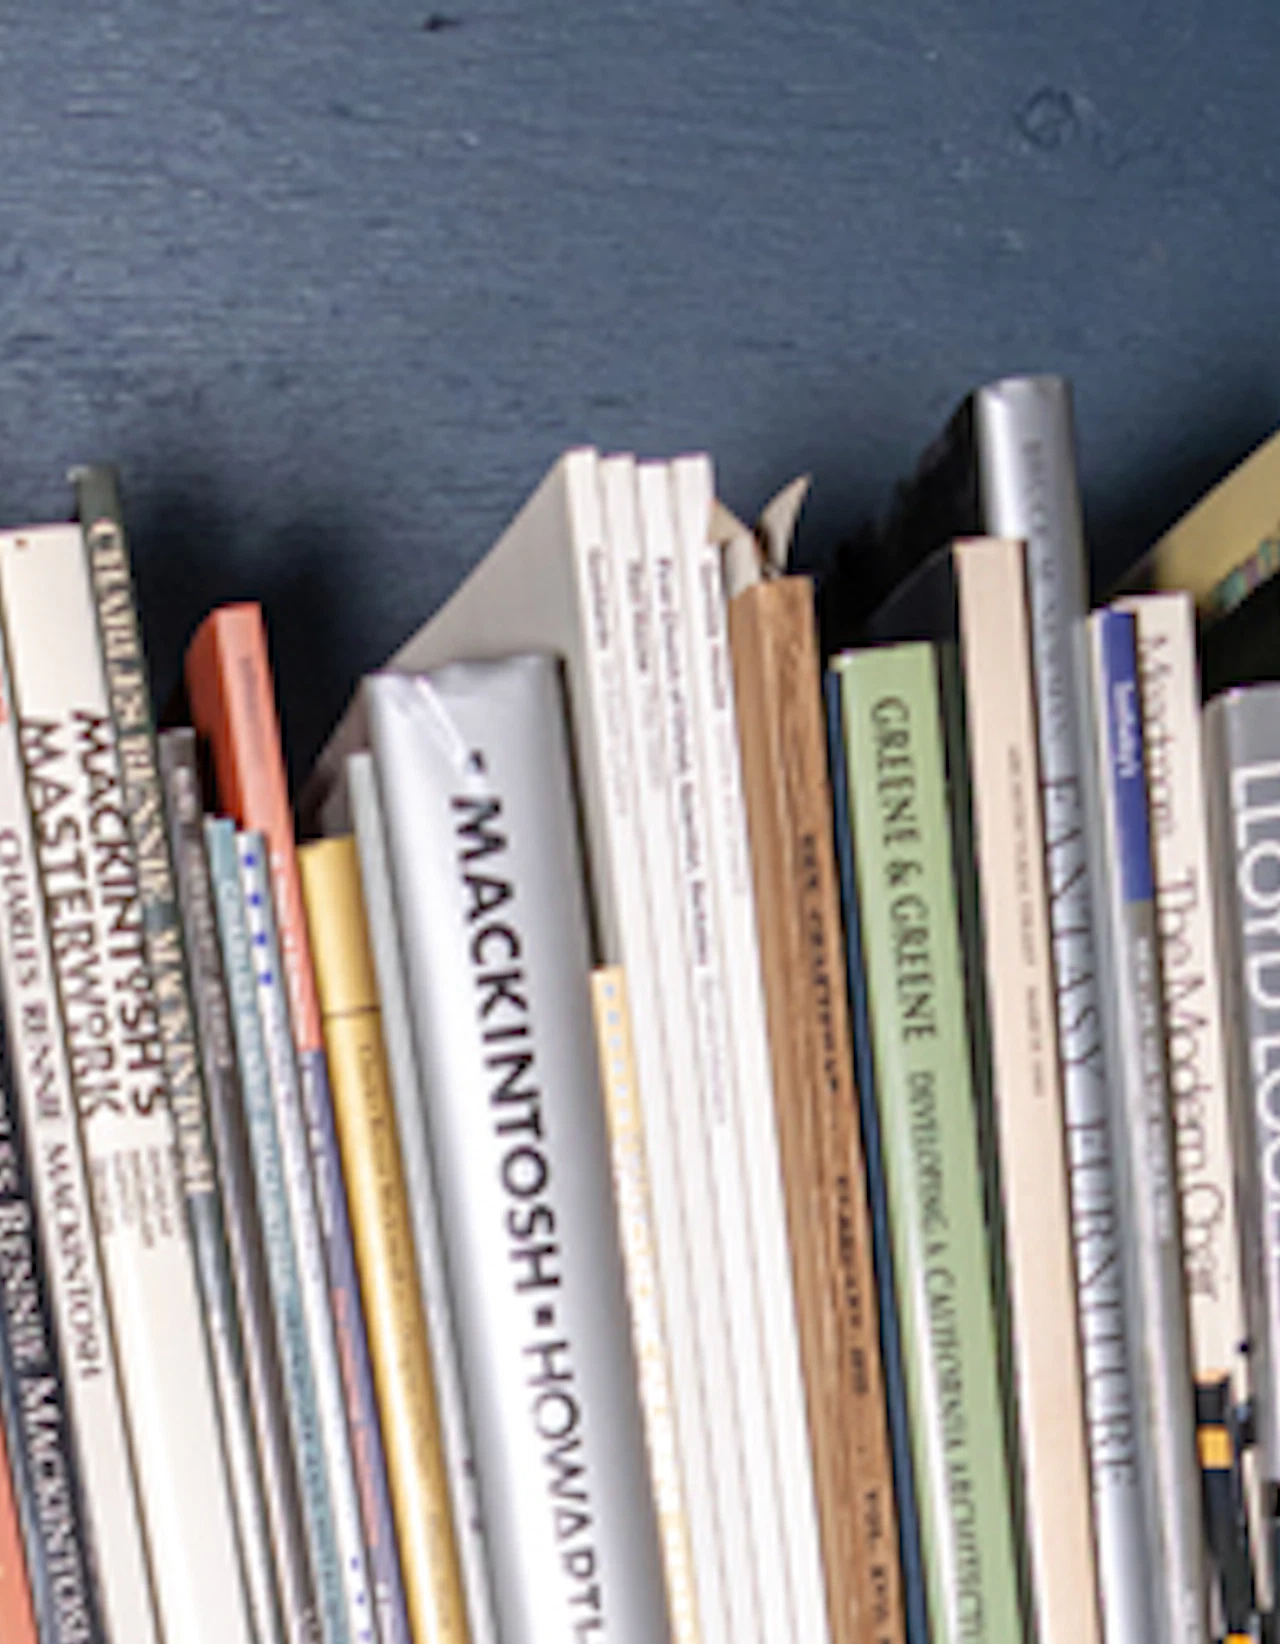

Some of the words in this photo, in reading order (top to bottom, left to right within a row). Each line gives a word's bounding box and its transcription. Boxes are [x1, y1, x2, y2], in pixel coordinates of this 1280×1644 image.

[865, 695, 926, 850] GREENE
[884, 858, 929, 890] &
[16, 708, 123, 1124] MASTERWORK
[888, 895, 949, 1046] GREENE
[1039, 772, 1102, 1082] FANTASY
[17, 1007, 64, 1125] RENNIE
[453, 792, 559, 1297] MACKINTOSH
[40, 1146, 109, 1390] MACKINTOSH
[1063, 1116, 1137, 1496] FURNITURE
